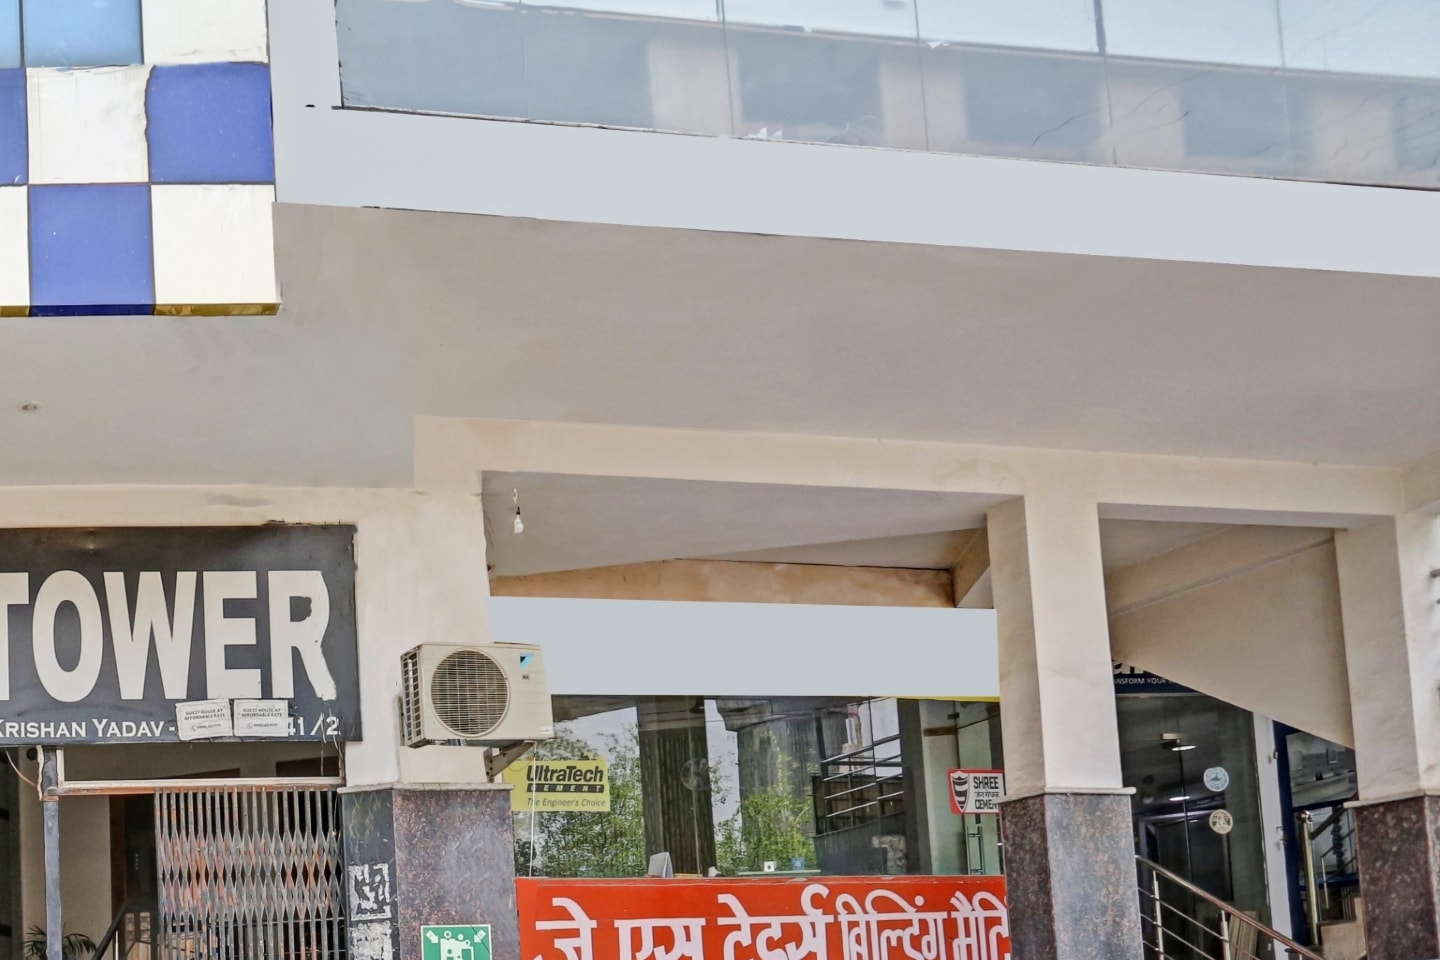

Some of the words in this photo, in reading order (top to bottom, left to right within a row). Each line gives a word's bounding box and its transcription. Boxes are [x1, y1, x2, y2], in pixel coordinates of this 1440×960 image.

[91, 718, 164, 737] YADAV
[526, 765, 603, 782] UltraTech
[531, 784, 600, 792] CEMENT
[973, 776, 999, 789] SHREE
[542, 798, 579, 807] Engineer's
[581, 798, 606, 806] Choice
